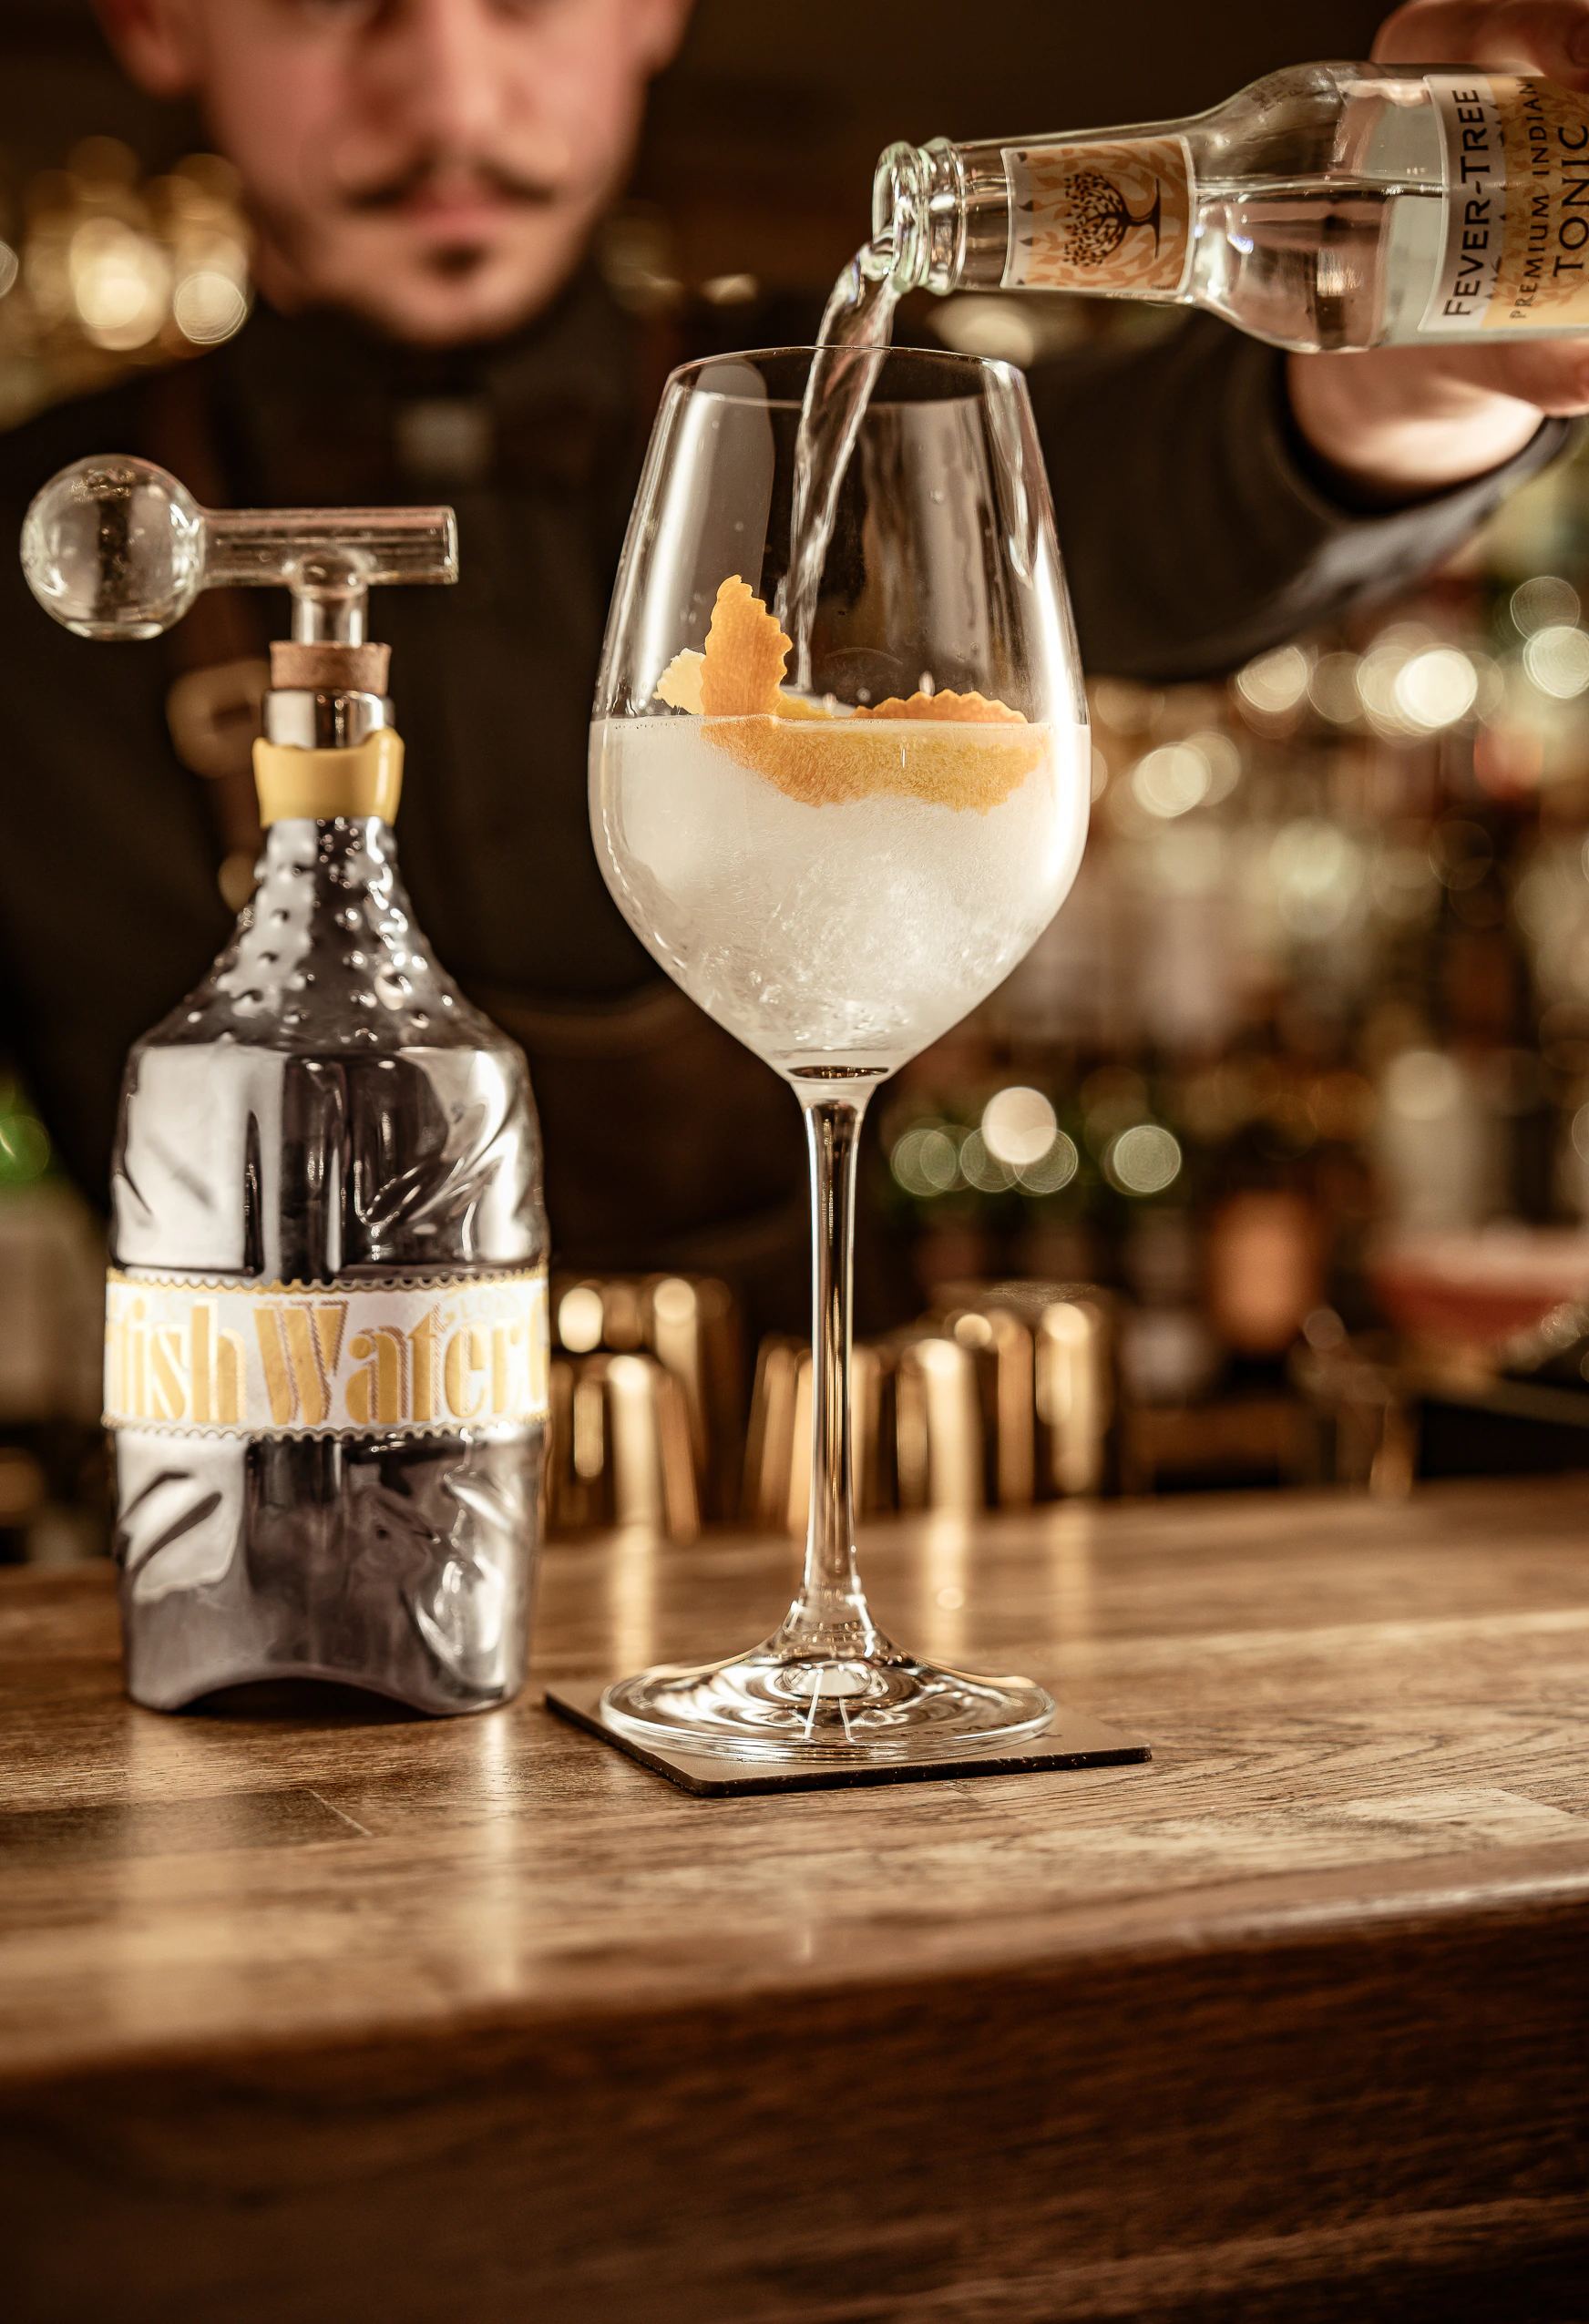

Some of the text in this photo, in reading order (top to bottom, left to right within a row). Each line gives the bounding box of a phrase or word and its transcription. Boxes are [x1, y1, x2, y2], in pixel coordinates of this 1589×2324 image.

[1442, 89, 1491, 316] FEVER-TREE
[1509, 83, 1550, 319] PREMIUM INDIAN
[1553, 125, 1589, 278] TONIC
[253, 1299, 521, 1426] Water
